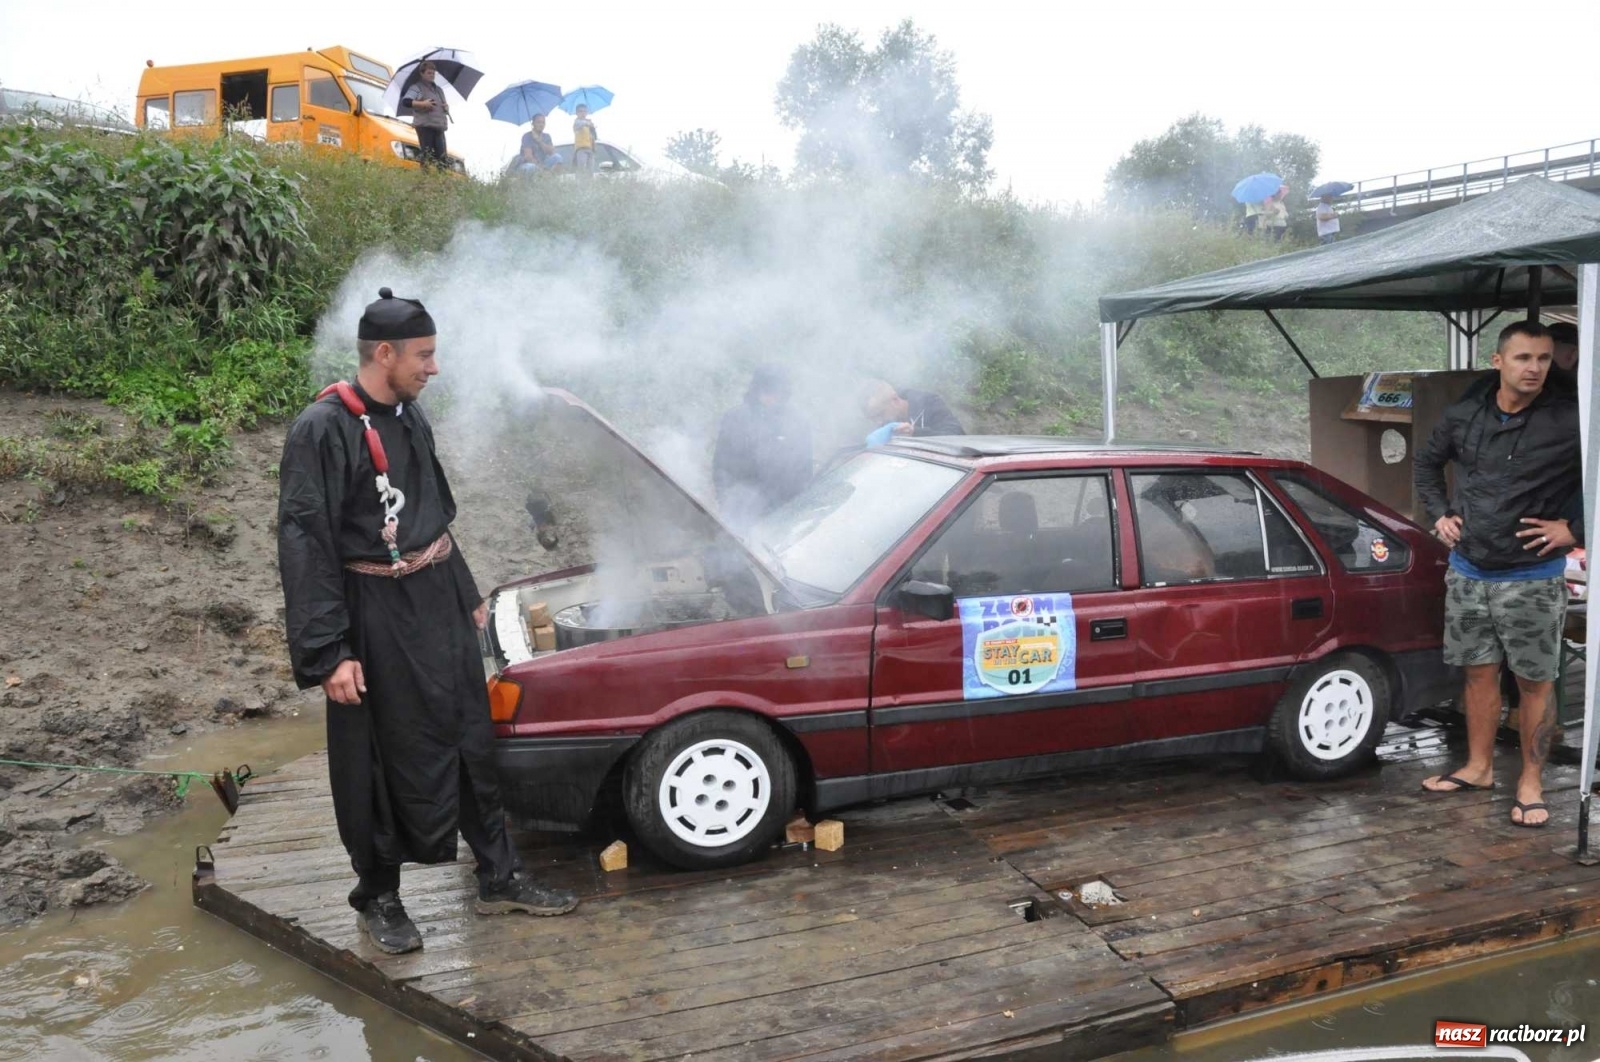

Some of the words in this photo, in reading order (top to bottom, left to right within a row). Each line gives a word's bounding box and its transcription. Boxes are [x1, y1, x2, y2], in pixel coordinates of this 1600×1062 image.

[1377, 393, 1401, 403] 666
[983, 645, 1020, 660] STAY
[1020, 648, 1052, 664] CAR
[1008, 668, 1032, 685] 01
